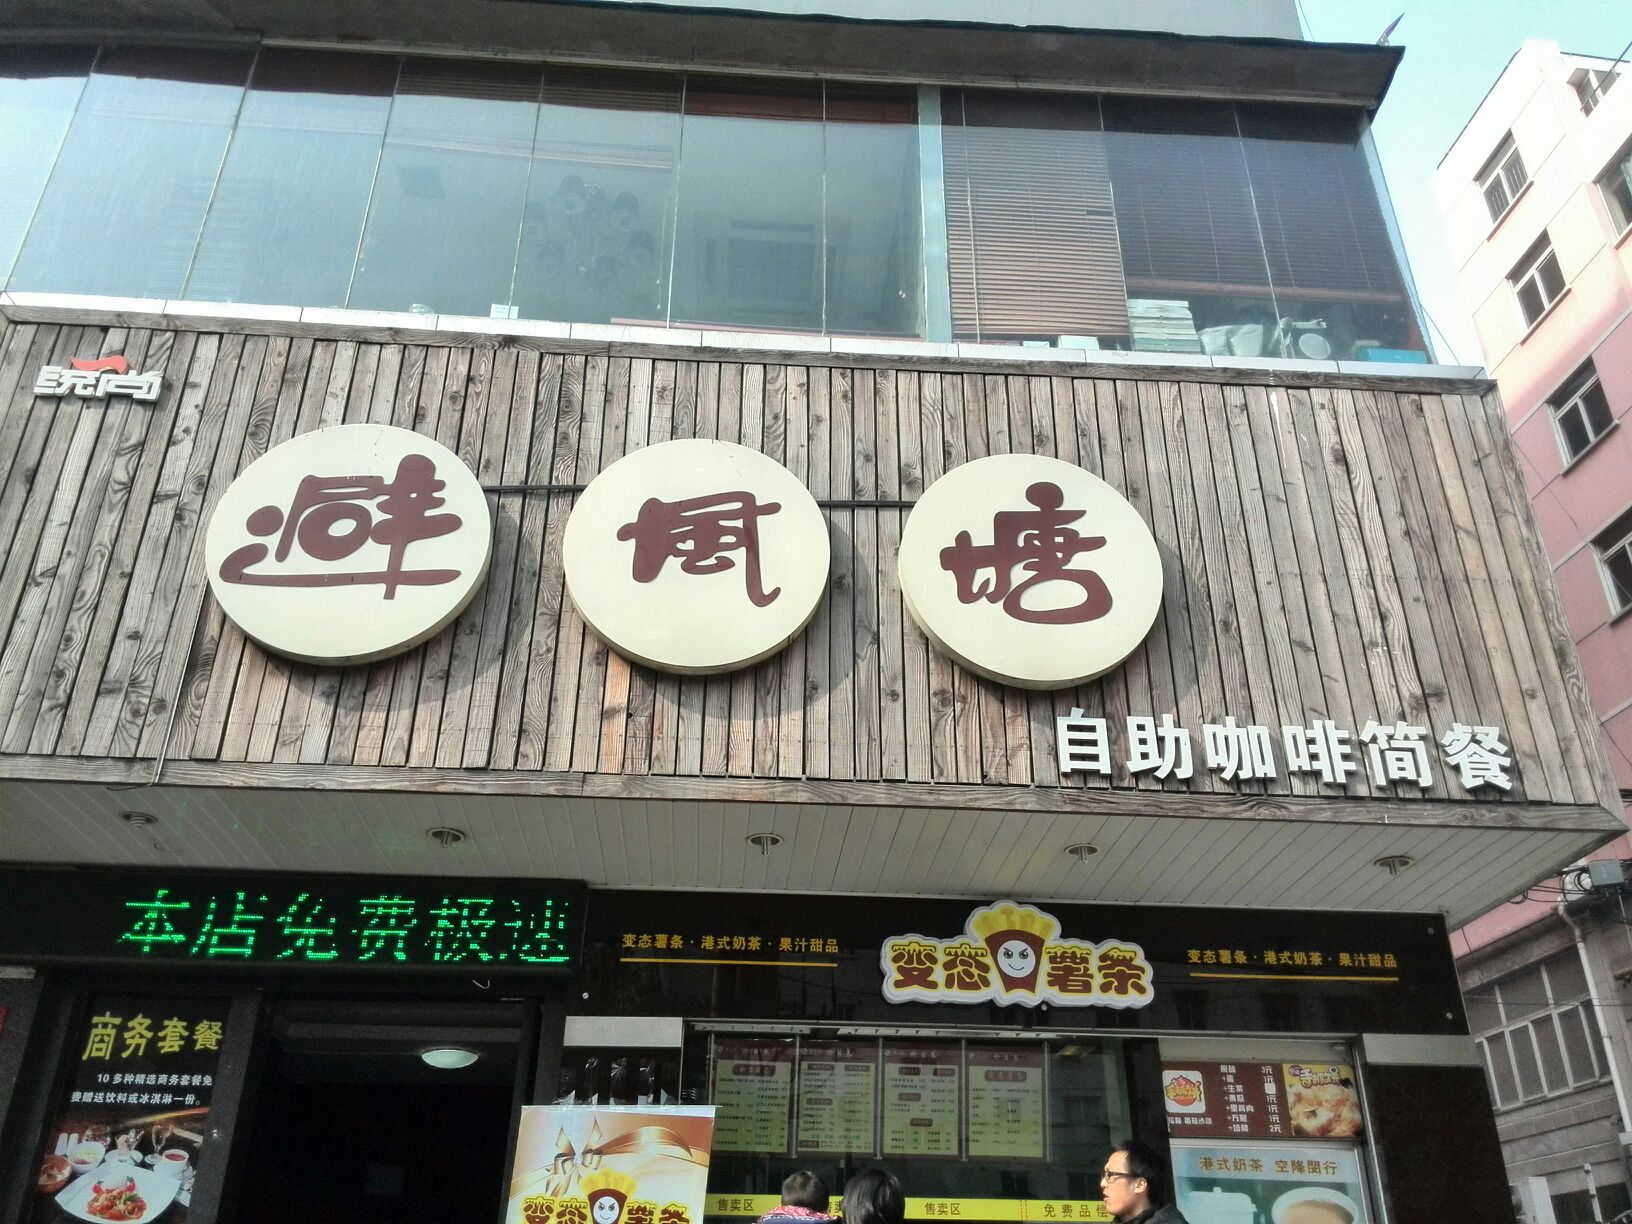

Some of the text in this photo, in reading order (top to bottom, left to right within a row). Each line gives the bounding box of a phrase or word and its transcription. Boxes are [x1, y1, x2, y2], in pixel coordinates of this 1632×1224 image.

[1056, 706, 1515, 792] 自助咖啡简餐
[82, 1011, 223, 1060] 商务套餐
[1199, 1156, 1263, 1173] 港式奶茶
[717, 1198, 754, 1212] 售卖区
[924, 1202, 961, 1215] 售卖区
